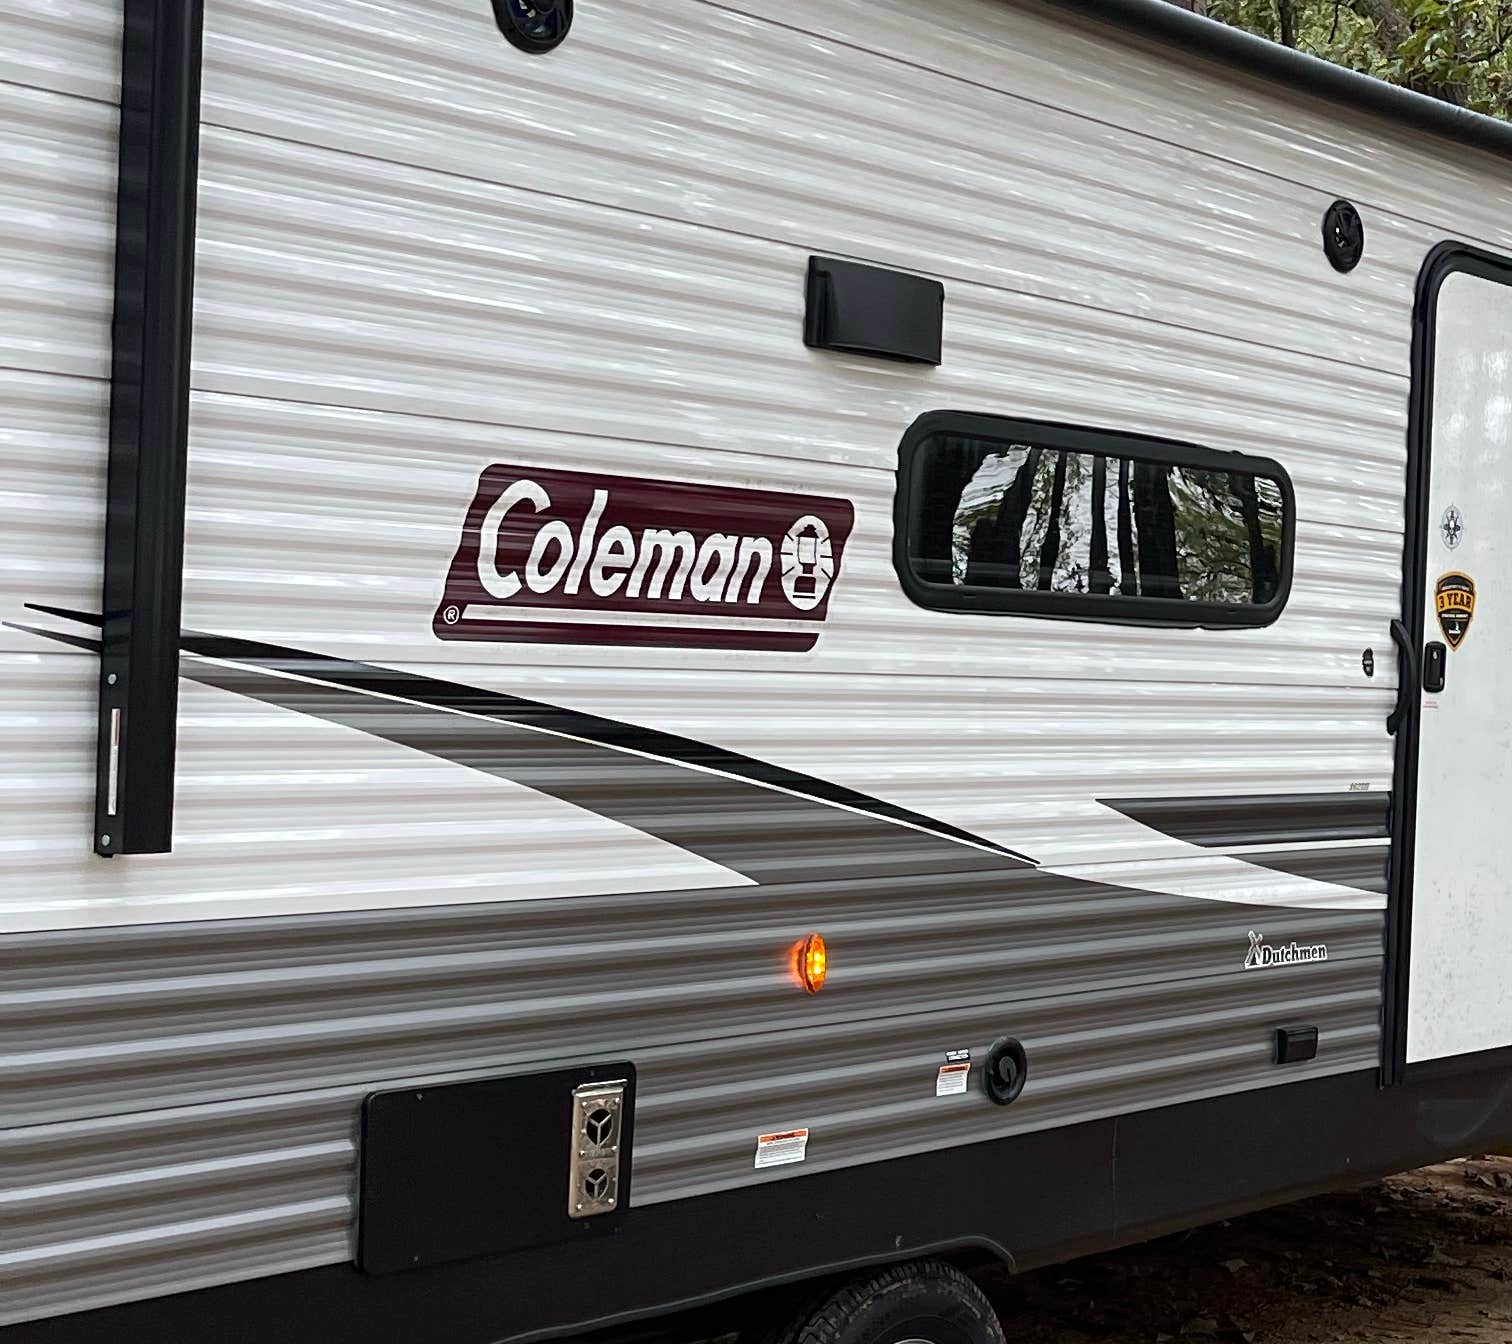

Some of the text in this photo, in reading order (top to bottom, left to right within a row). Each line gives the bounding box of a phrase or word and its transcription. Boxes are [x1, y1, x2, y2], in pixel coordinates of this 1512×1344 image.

[476, 479, 774, 605] Coleman
[1447, 592, 1471, 609] YEAR
[1262, 943, 1326, 965] Dutchmen
